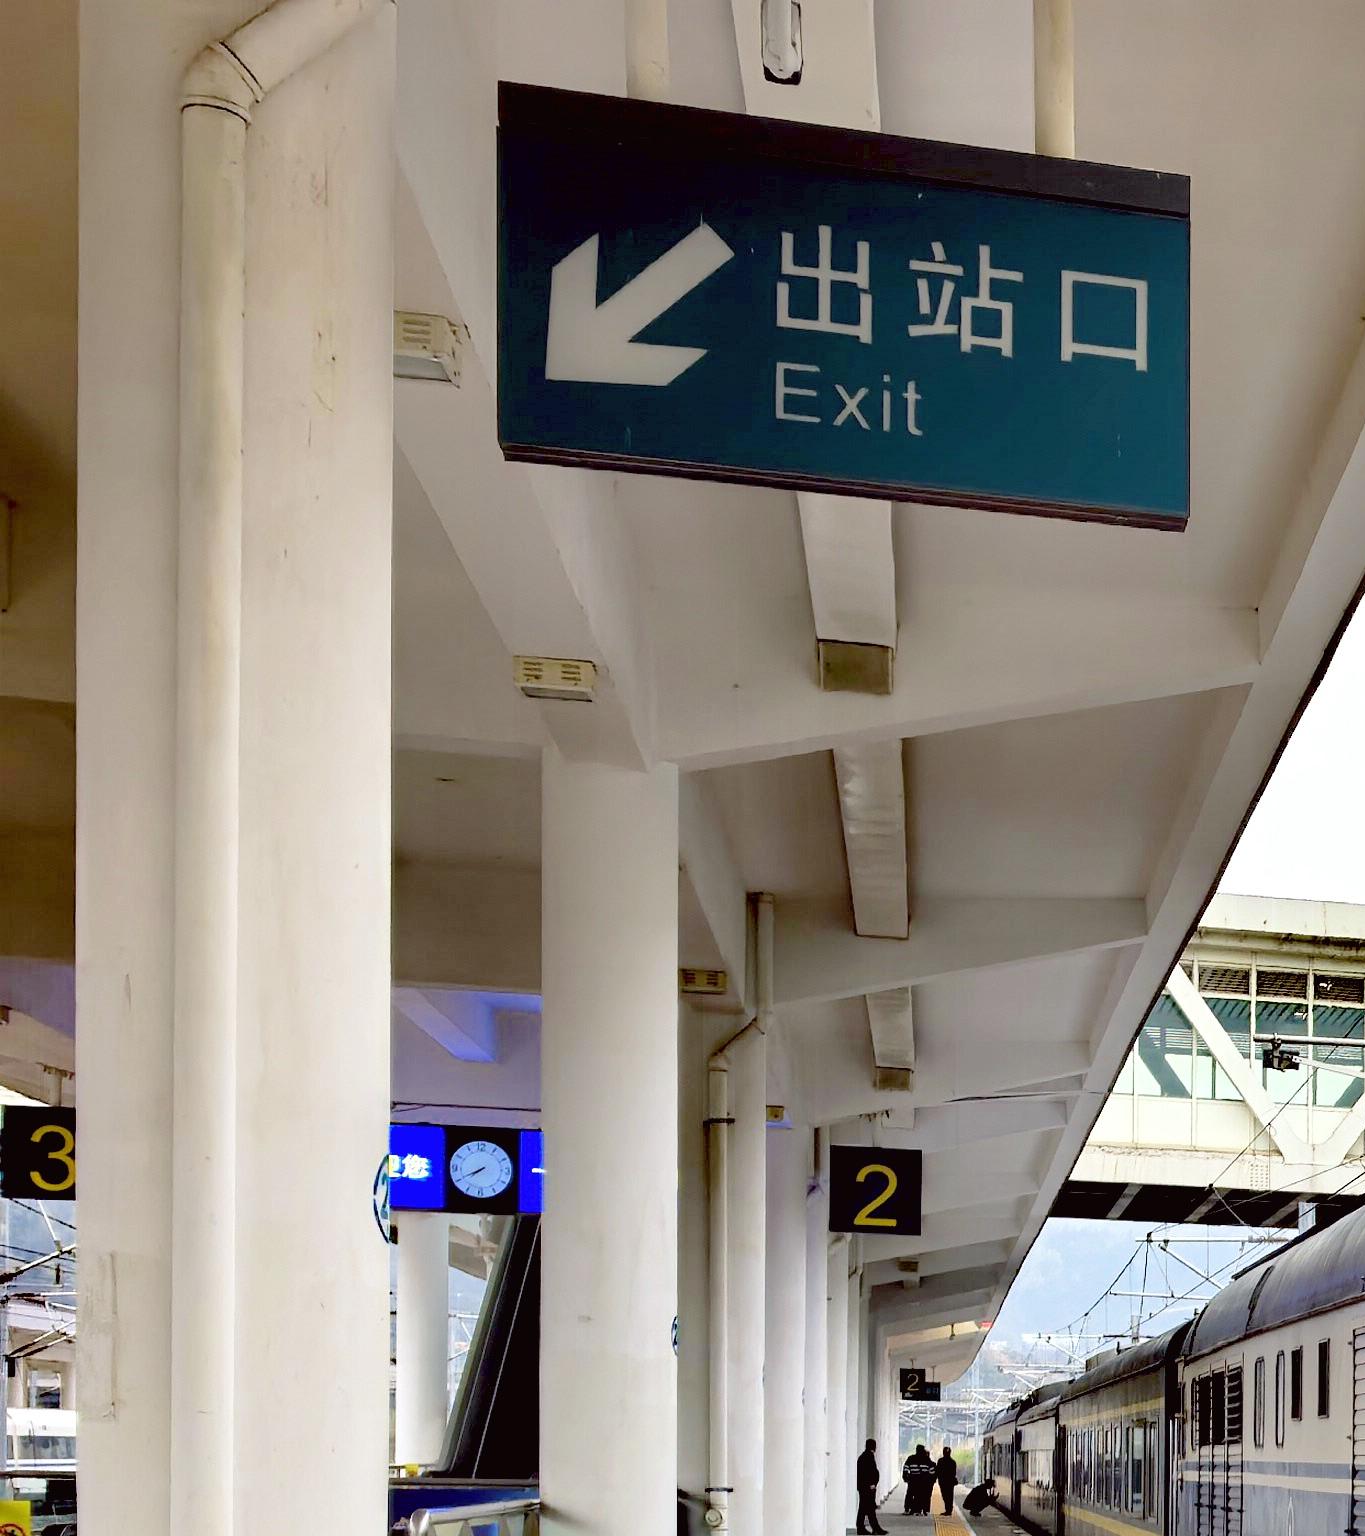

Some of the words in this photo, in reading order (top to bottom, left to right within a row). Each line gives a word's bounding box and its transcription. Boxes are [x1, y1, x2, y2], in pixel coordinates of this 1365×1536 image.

[777, 225, 1148, 372] 出站口
[775, 361, 923, 436] Exit
[30, 1125, 76, 1191] 3
[854, 1164, 897, 1226] 2
[907, 1374, 919, 1391] 2
